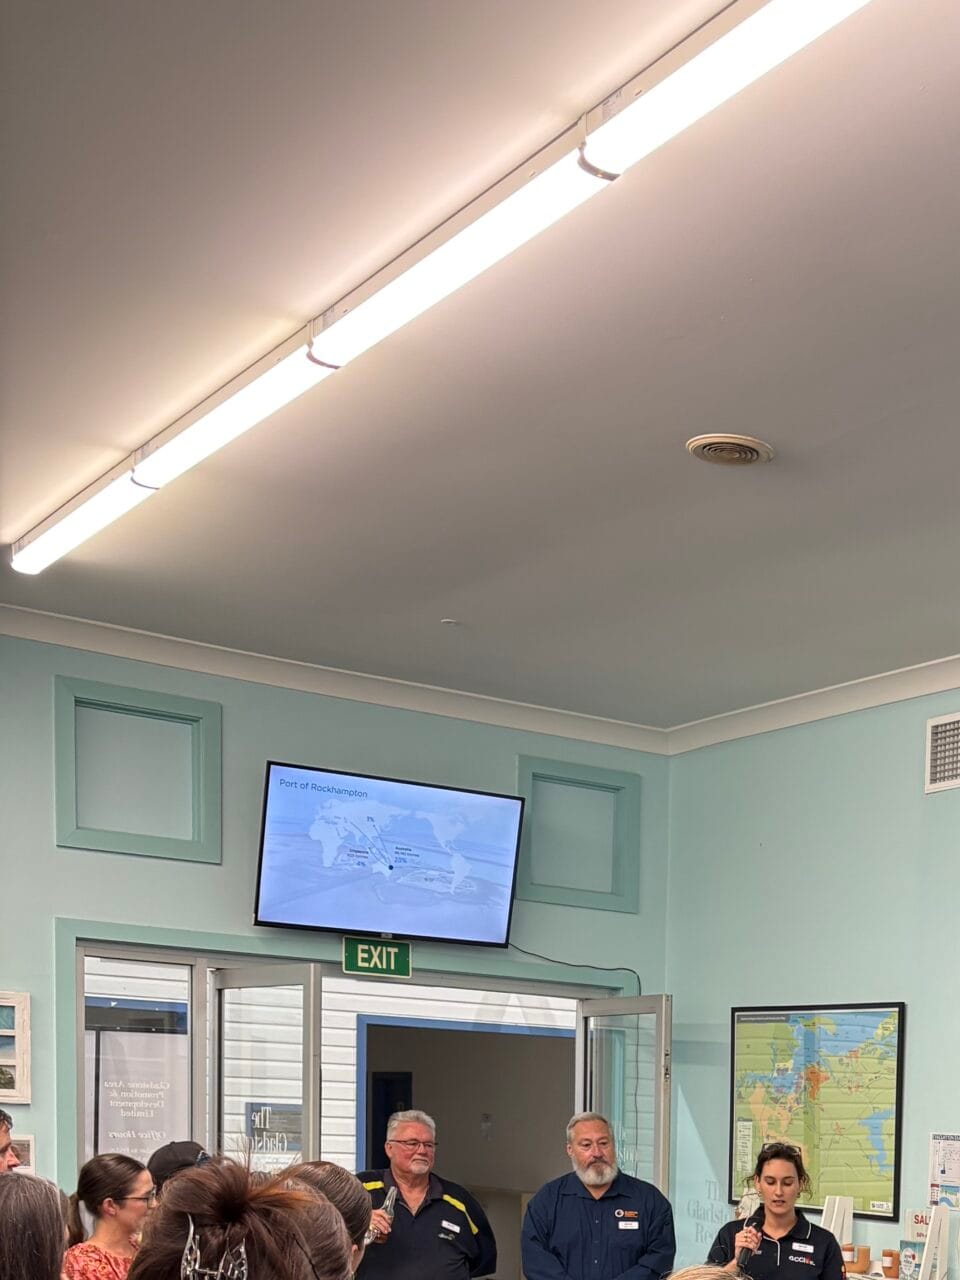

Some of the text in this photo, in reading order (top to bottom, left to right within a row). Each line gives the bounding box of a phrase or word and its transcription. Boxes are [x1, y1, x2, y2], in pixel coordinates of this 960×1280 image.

[279, 779, 368, 799] Port of Rockhampton
[357, 944, 399, 970] EXIT
